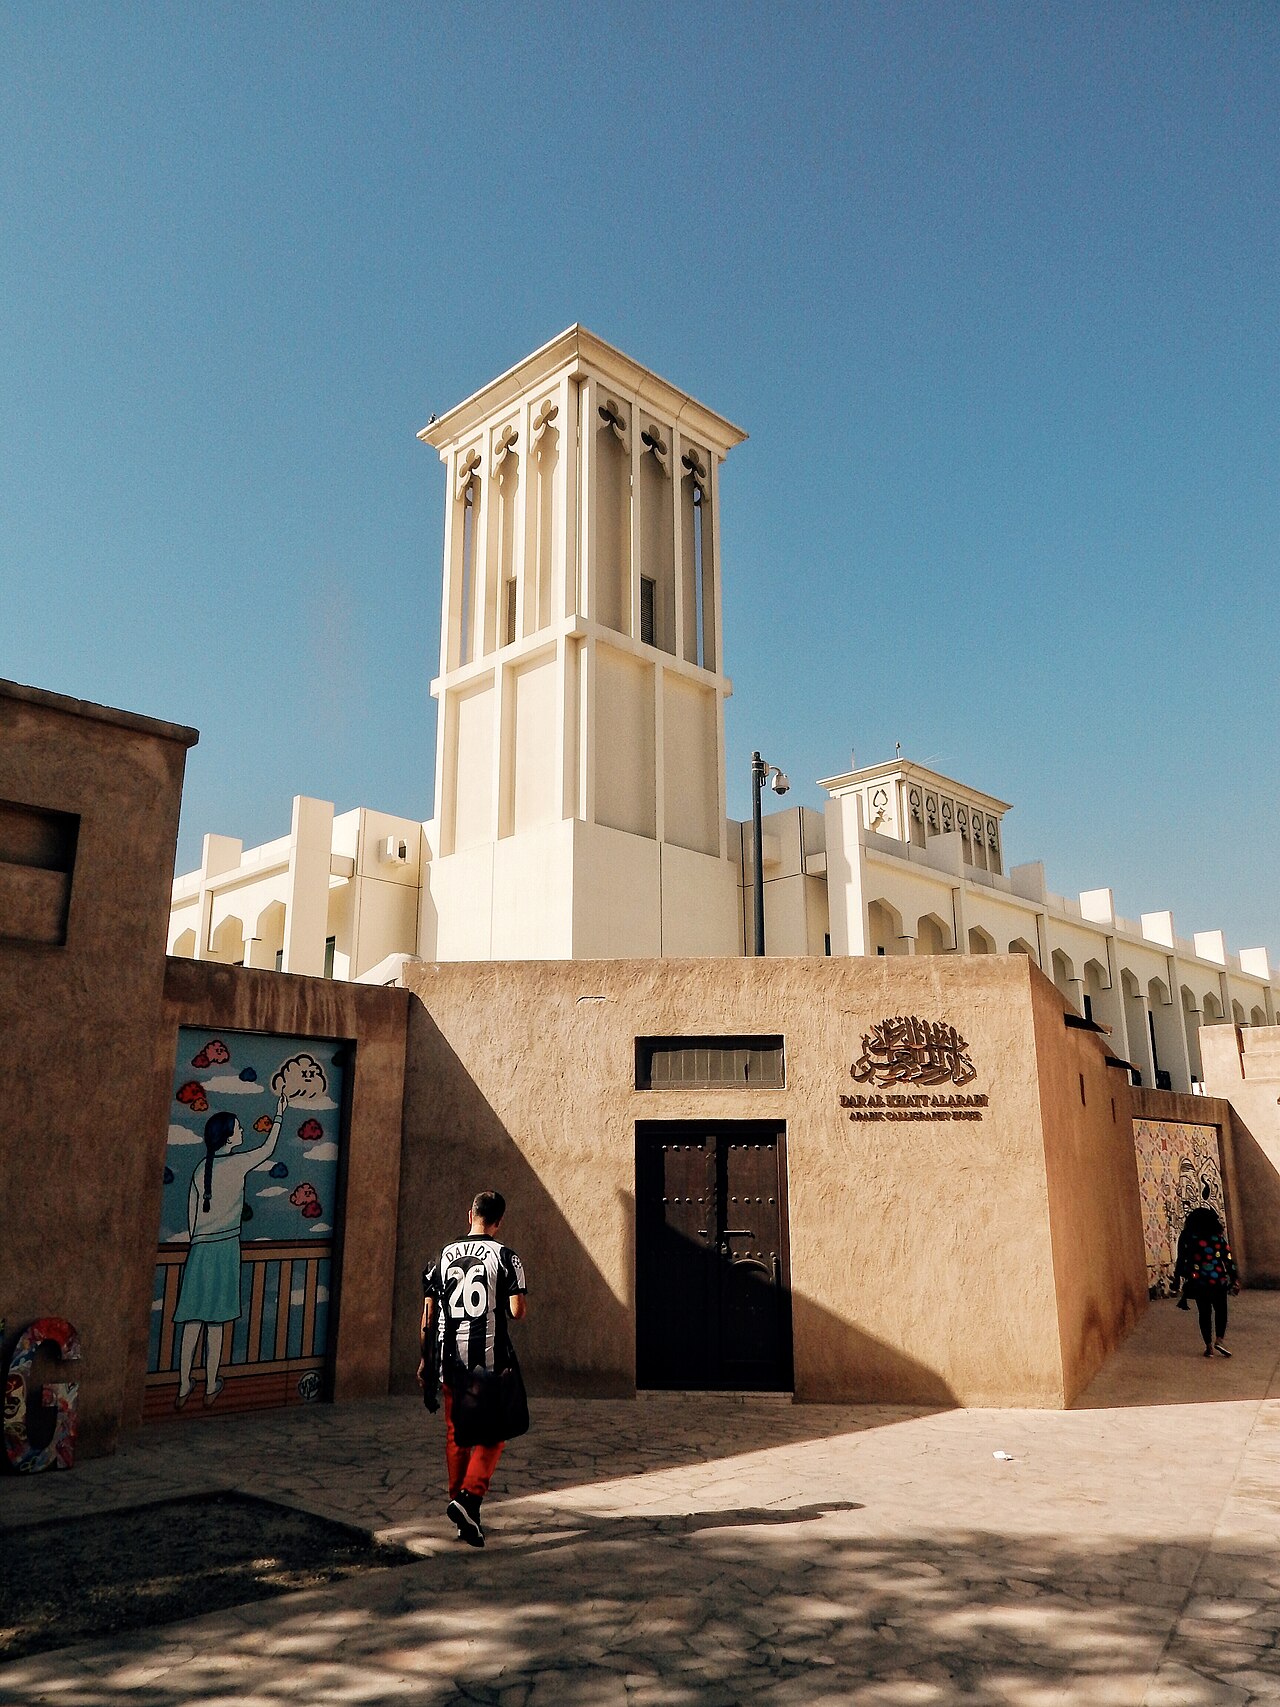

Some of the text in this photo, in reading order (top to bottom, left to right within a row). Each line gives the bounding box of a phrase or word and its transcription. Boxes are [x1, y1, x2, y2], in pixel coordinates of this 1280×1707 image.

[885, 1094, 930, 1108] KHATT
[446, 1243, 490, 1262] DAVIDS
[447, 1265, 487, 1319] 26
